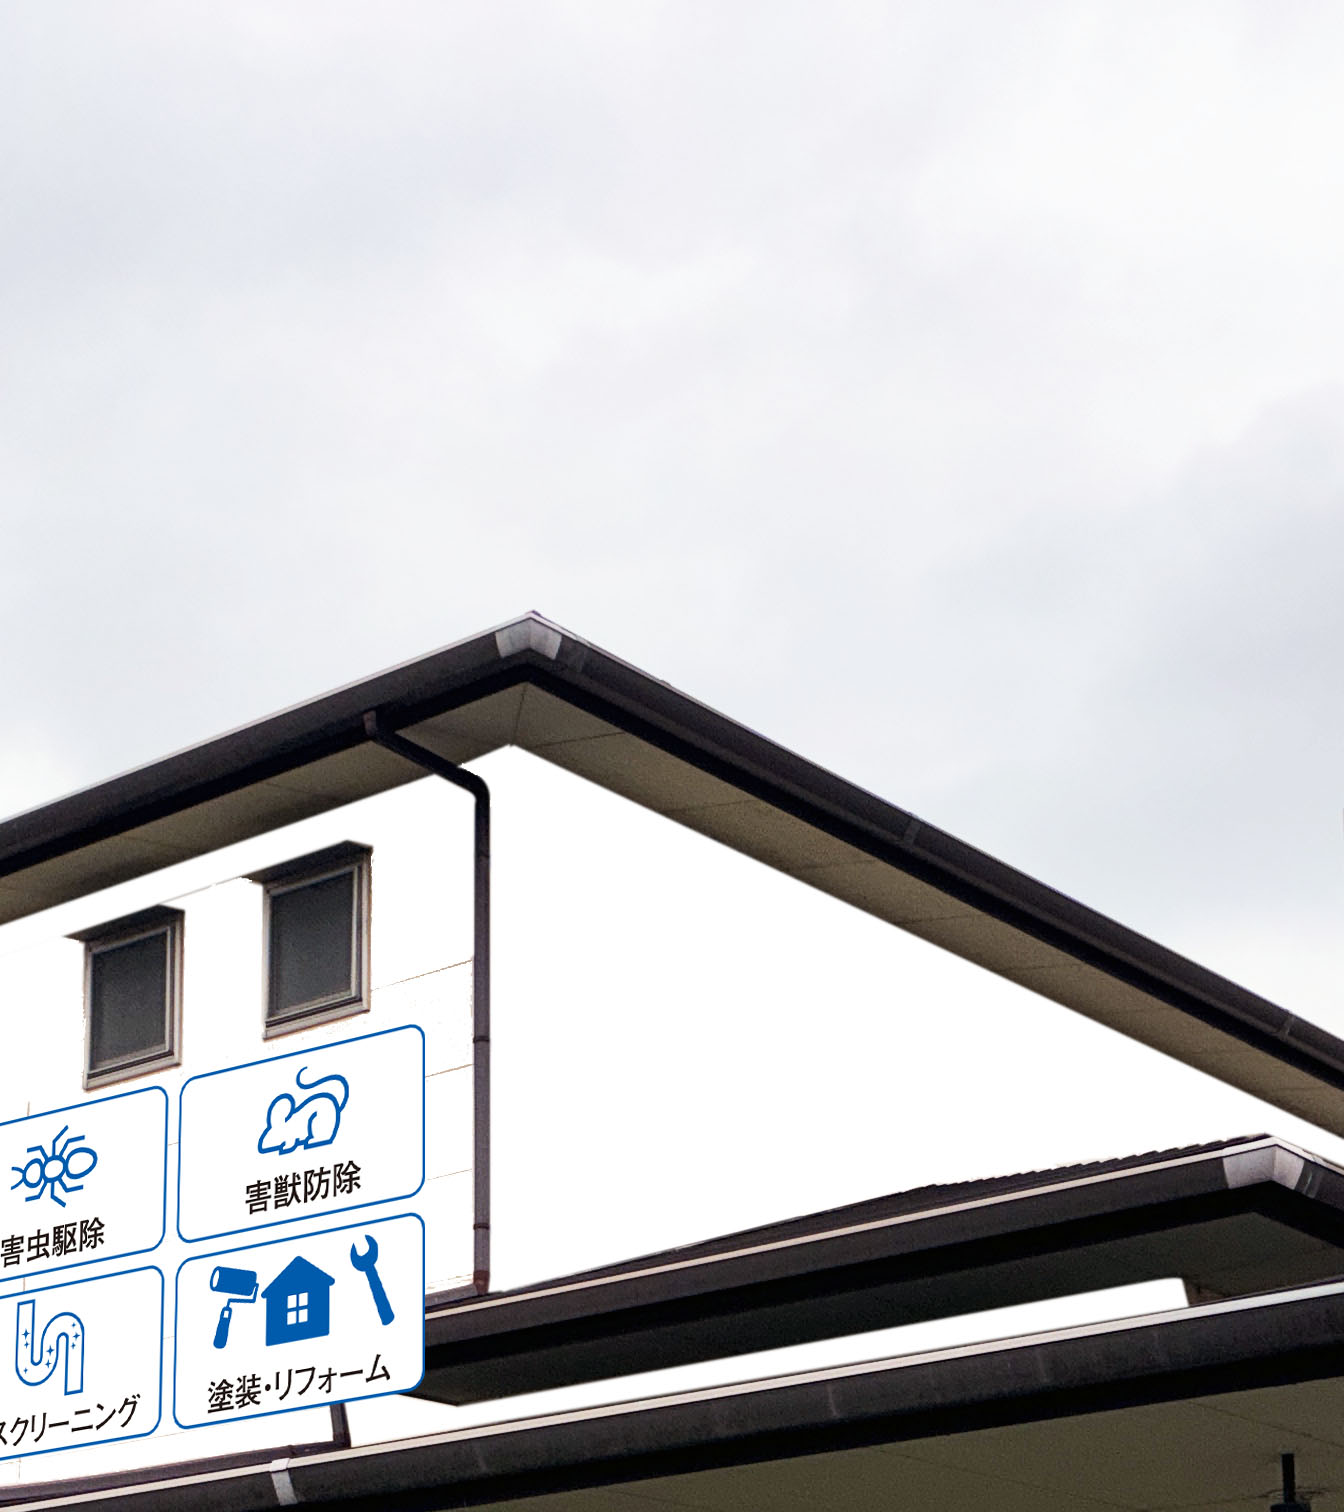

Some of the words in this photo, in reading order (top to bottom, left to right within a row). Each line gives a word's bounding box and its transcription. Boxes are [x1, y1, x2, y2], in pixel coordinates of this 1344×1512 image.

[245, 1160, 362, 1214] 害獣防除
[0, 1217, 105, 1268] 害虫駆除
[207, 1354, 391, 1414] 塗装・リフォーム
